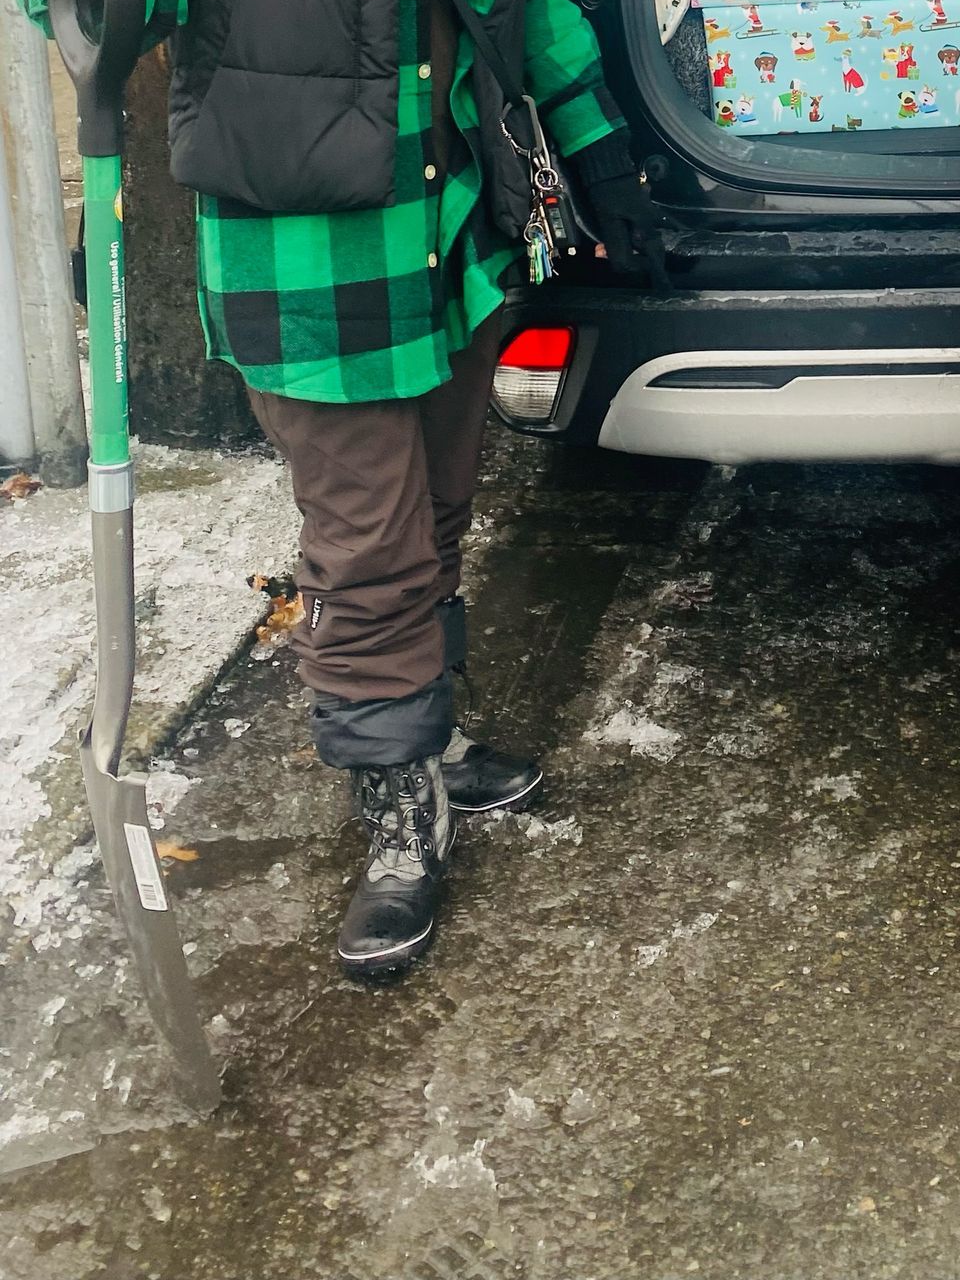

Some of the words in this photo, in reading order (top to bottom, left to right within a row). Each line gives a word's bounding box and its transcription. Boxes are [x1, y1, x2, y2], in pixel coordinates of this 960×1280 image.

[111, 241, 119, 258] Uso
[110, 260, 120, 293] general
[113, 299, 121, 343] Utilisation
[114, 344, 123, 383] Générale
